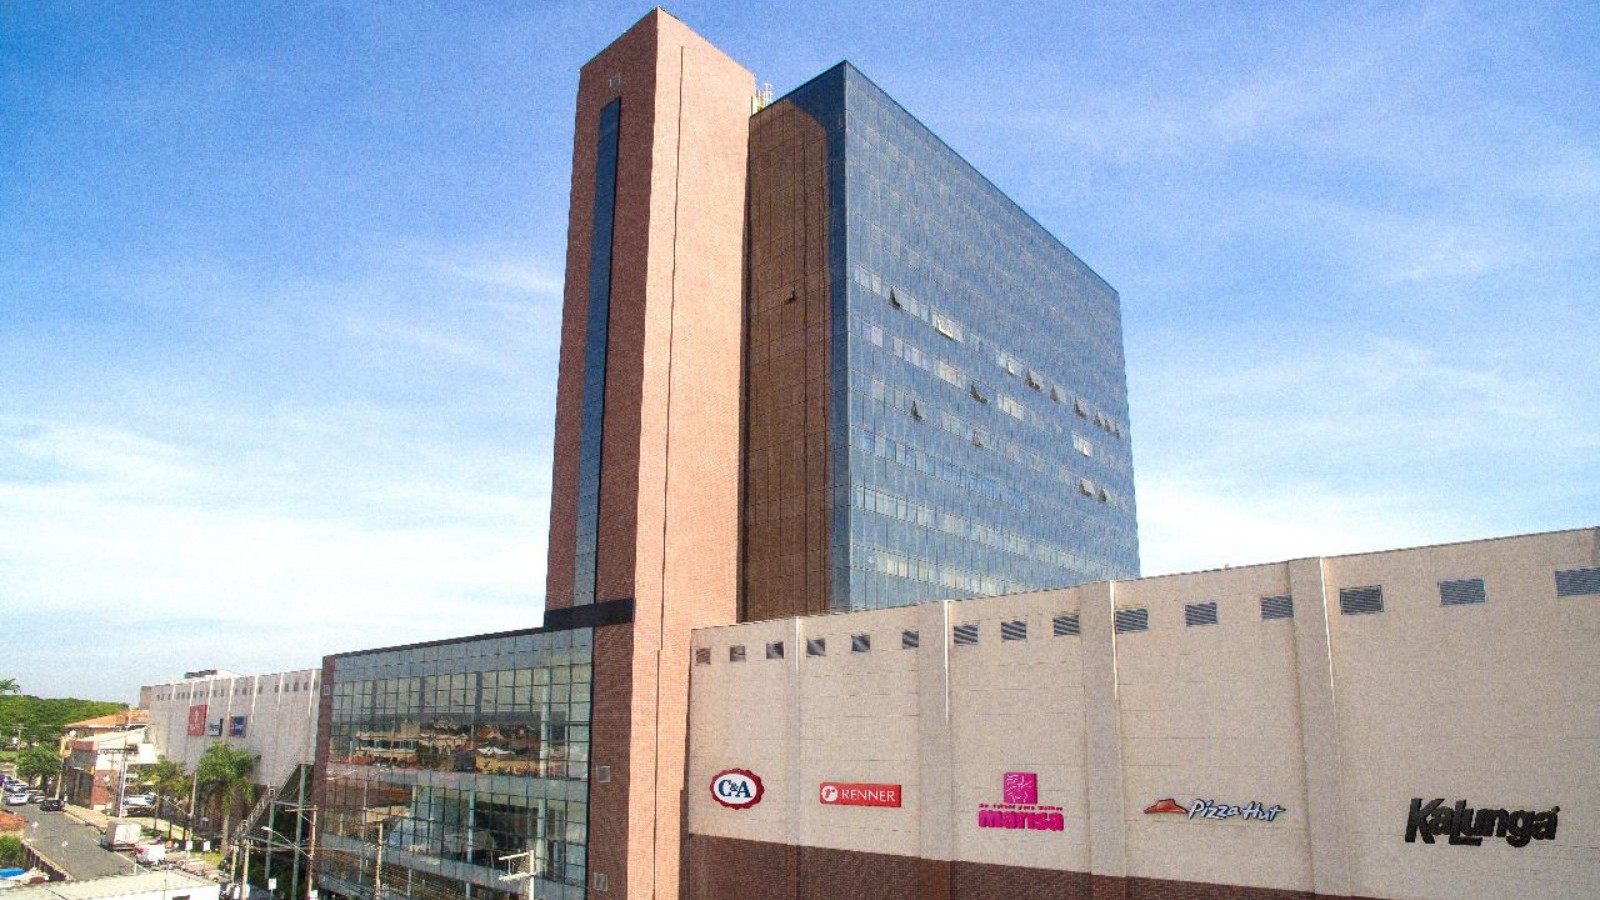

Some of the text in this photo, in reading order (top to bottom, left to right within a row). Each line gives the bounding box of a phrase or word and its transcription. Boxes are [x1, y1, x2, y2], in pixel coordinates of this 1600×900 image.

[718, 779, 752, 798] C&A
[841, 789, 896, 802] RENNER
[1187, 798, 1287, 821] Pizza Hut
[978, 809, 1064, 831] marisa
